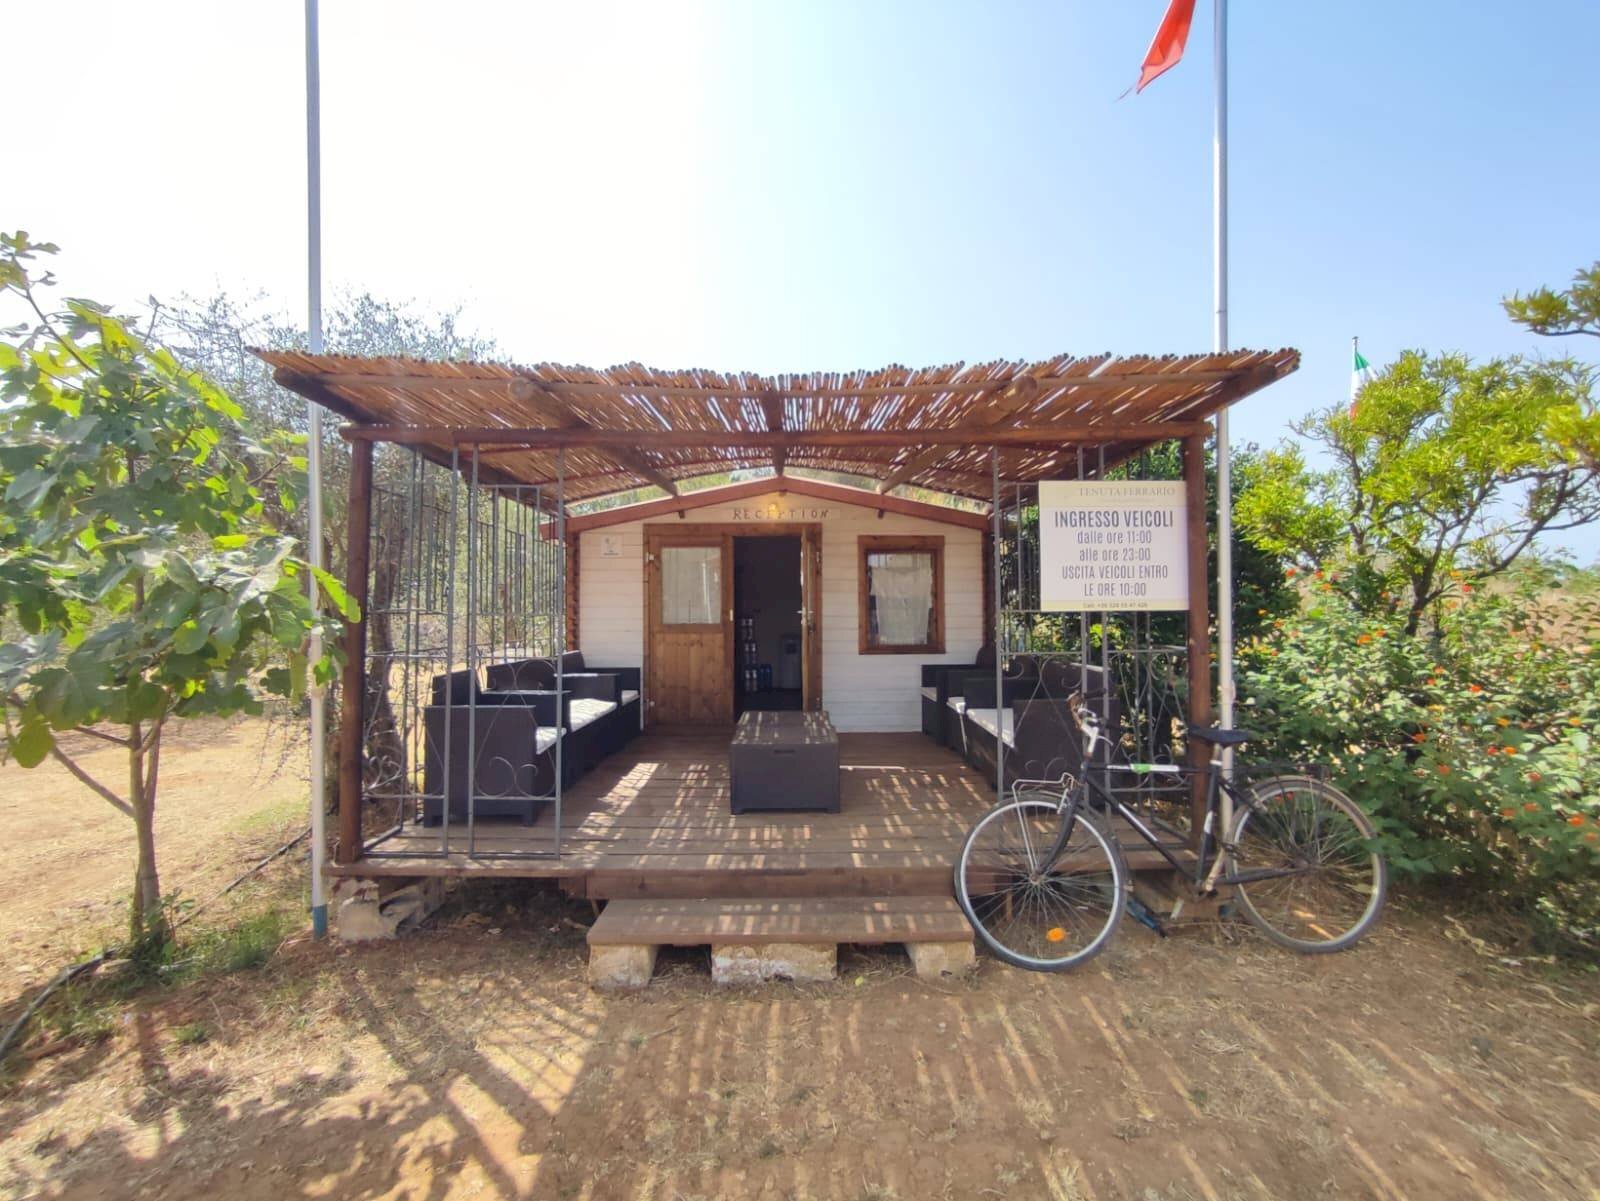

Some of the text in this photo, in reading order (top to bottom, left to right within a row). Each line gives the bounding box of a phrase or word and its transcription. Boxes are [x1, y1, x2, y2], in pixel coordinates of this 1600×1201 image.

[1080, 487, 1176, 497] TENUTA FERRARIO
[732, 508, 829, 521] RECEPTION
[1054, 510, 1174, 528] INGRESSO VEICOLI
[1077, 530, 1152, 544] dalle ore 11:00
[1079, 548, 1151, 562] alle ore 23:00
[1062, 565, 1168, 579] USCITA VEICOLI ENTRO
[1084, 583, 1147, 596] LE ORE 10:00
